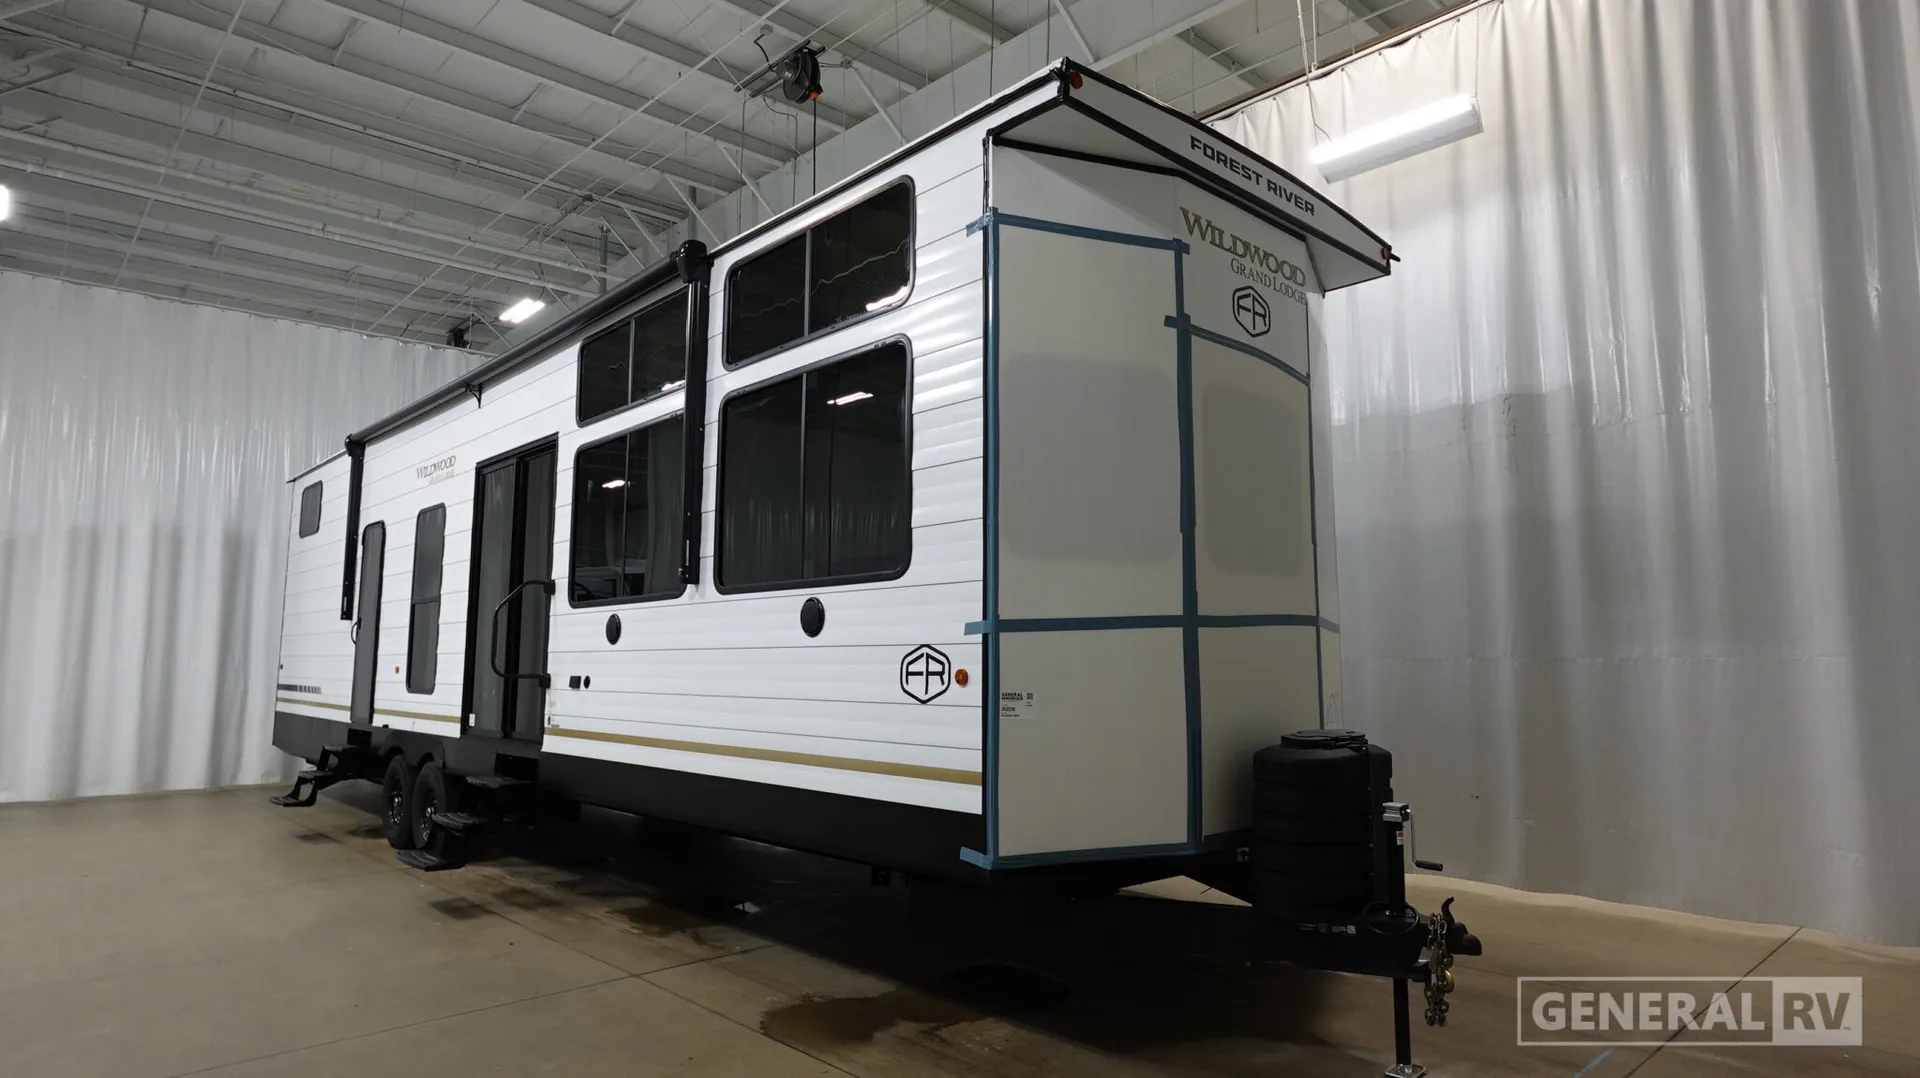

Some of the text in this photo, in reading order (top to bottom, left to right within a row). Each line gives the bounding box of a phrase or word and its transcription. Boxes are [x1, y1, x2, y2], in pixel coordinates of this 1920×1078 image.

[1189, 134, 1315, 216] FOREST RIVER
[1179, 206, 1306, 287] WILDWOOD
[1230, 258, 1307, 305] GRAND LODGE
